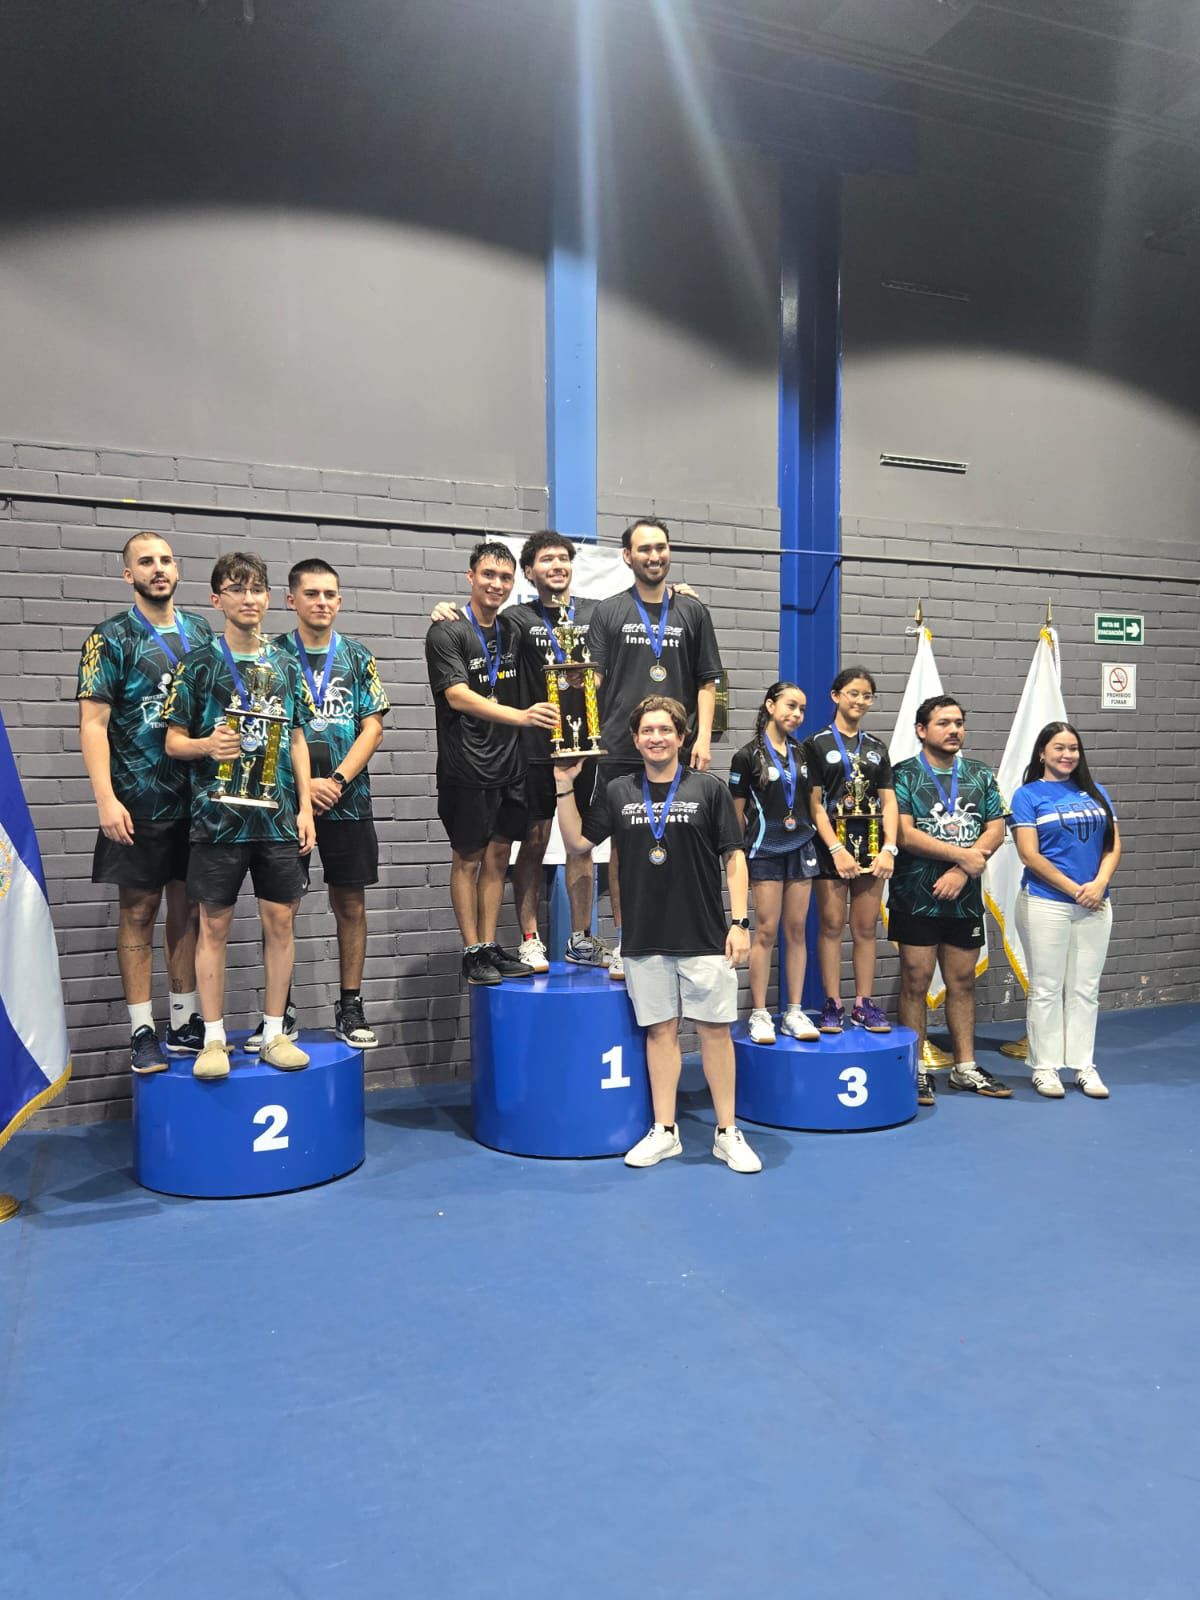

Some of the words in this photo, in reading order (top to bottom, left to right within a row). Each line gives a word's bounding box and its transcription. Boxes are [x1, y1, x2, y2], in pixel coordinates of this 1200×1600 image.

[601, 1045, 631, 1090] 1
[837, 1066, 869, 1107] 3
[252, 1104, 289, 1153] 2
